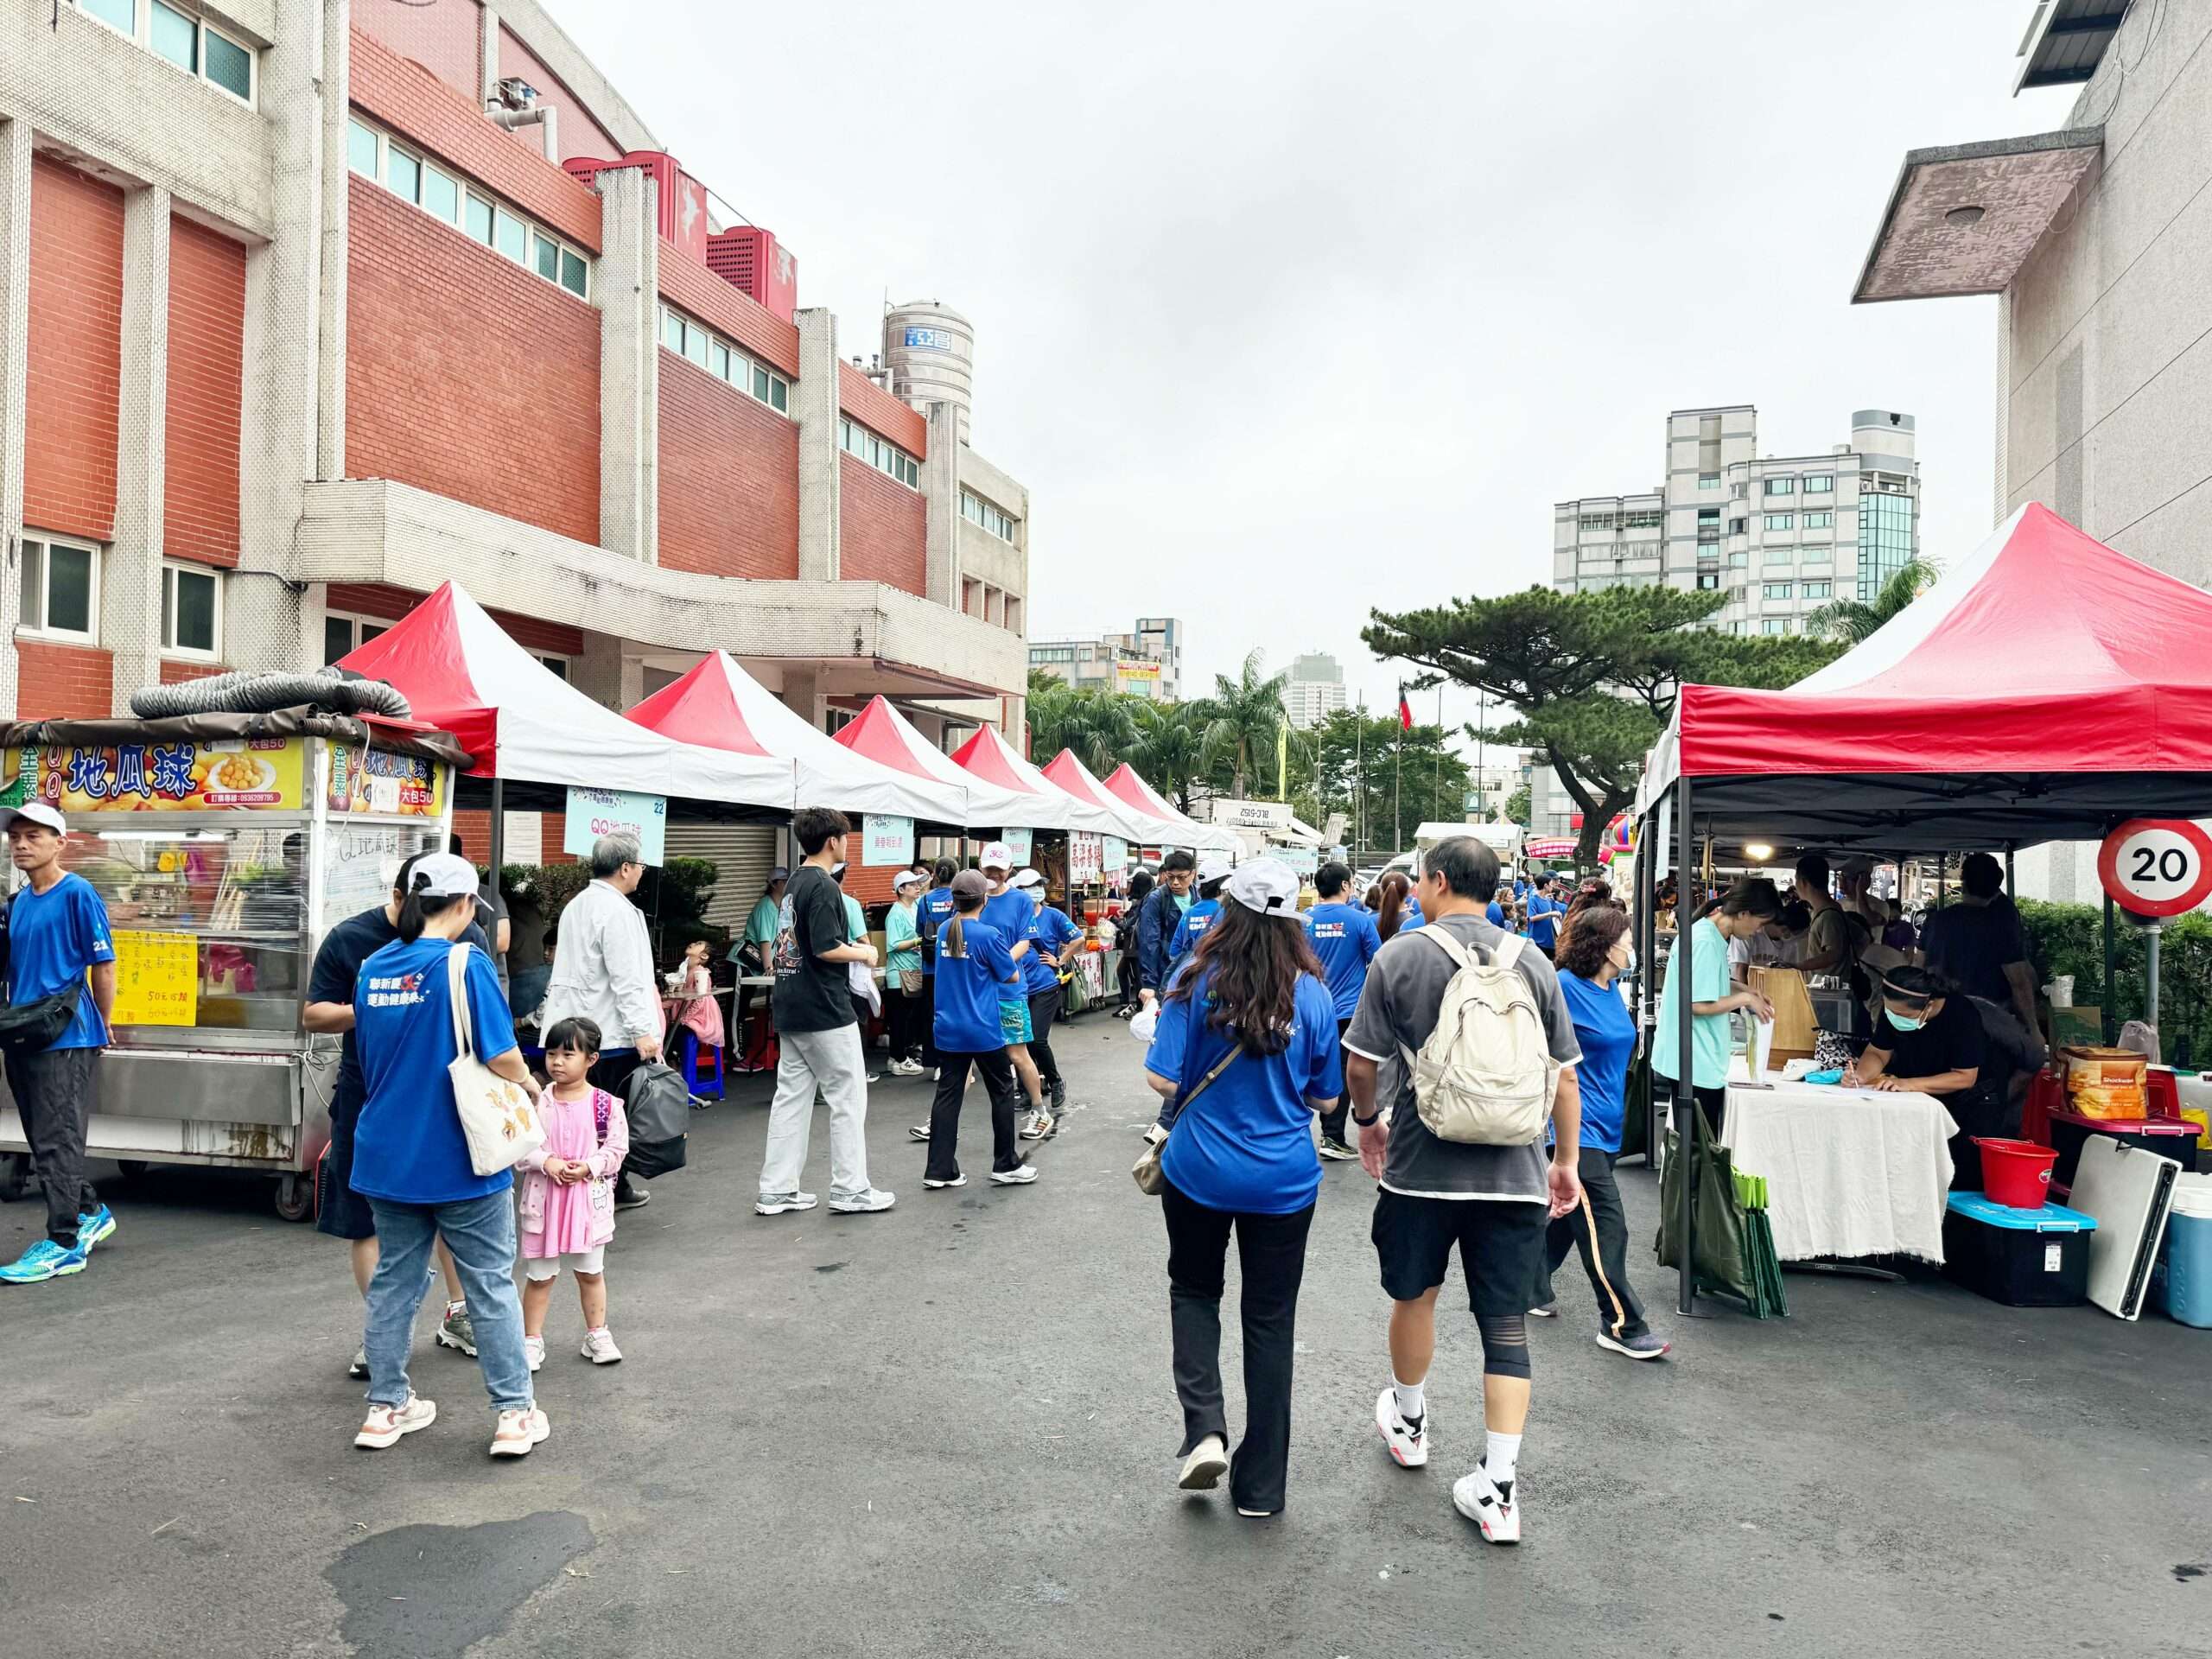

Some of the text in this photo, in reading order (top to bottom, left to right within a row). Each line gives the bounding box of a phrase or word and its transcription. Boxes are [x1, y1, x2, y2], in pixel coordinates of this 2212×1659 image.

[19, 744, 40, 800] 全素
[68, 741, 196, 799] 地瓜球
[334, 747, 346, 797] 全素
[654, 802, 664, 815] 22
[2132, 848, 2188, 881] 20
